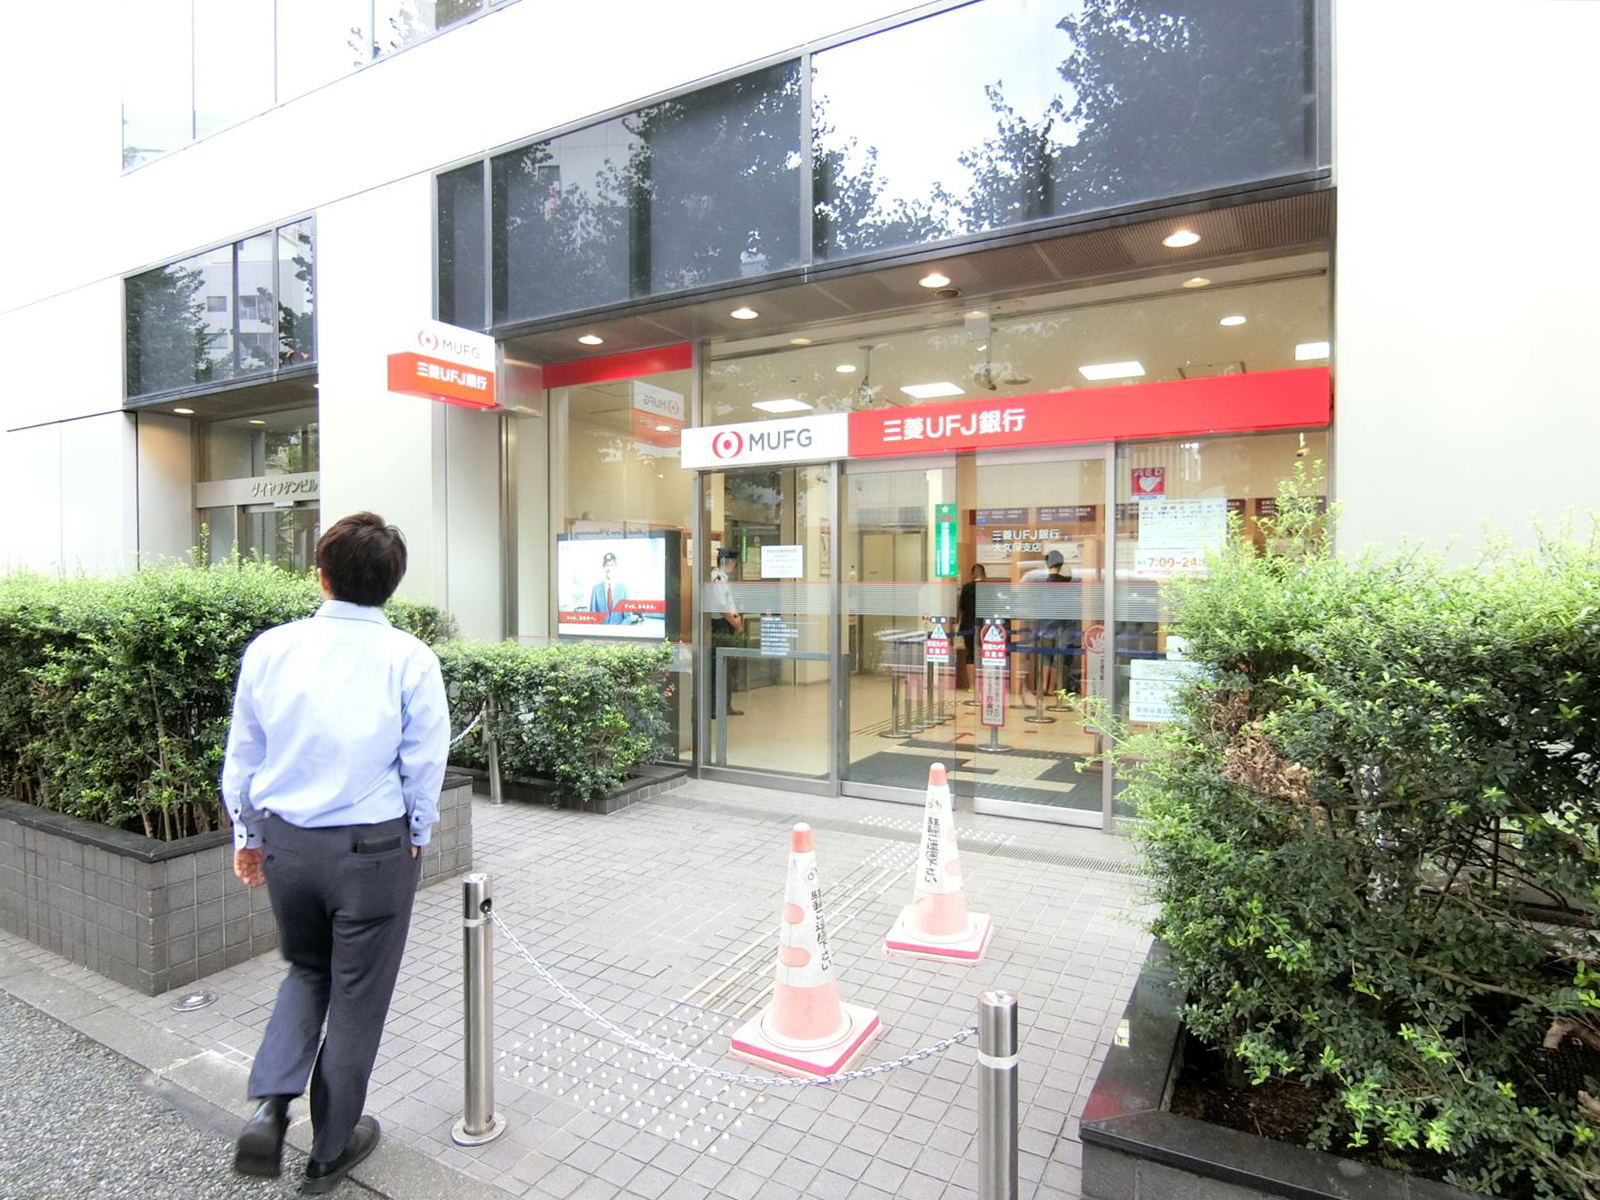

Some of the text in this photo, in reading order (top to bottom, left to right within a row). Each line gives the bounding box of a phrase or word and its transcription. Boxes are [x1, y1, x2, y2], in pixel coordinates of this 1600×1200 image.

[442, 339, 481, 359] MUFG
[883, 408, 1026, 442] 三菱UFJ銀行
[749, 428, 812, 452] MUFG
[1133, 468, 1163, 477] AED
[992, 528, 1060, 541] 三菱UFJ銀行
